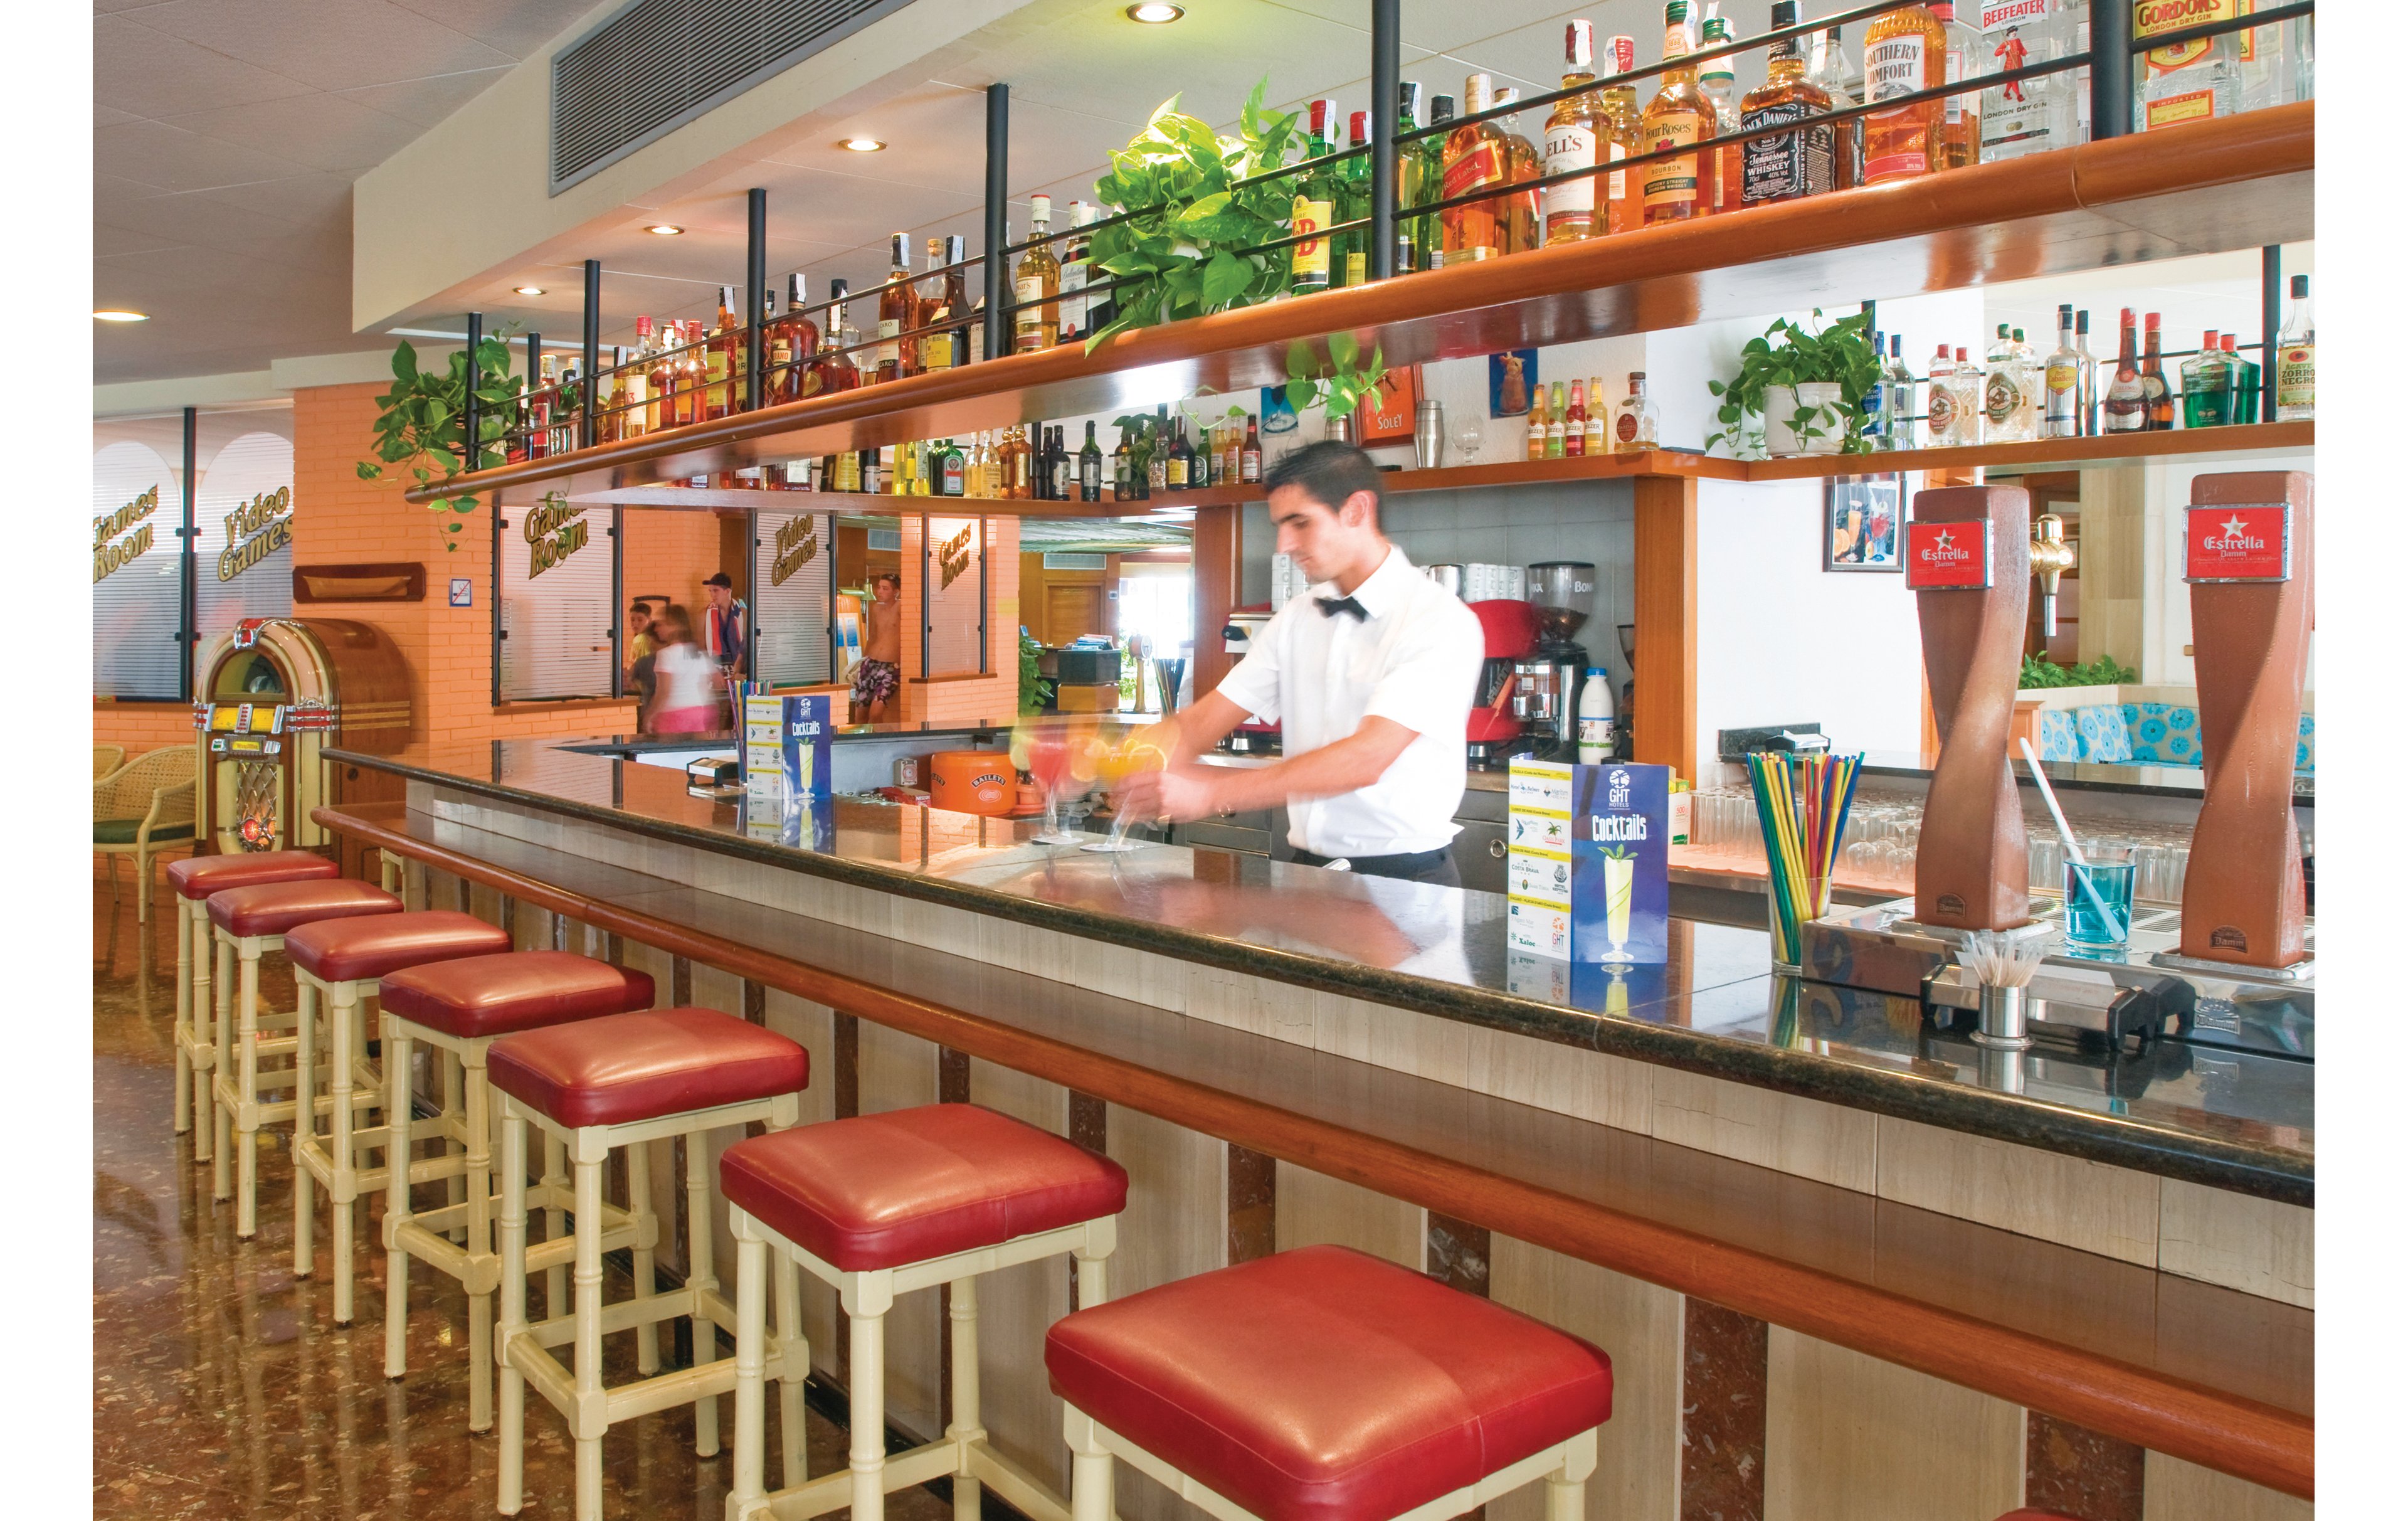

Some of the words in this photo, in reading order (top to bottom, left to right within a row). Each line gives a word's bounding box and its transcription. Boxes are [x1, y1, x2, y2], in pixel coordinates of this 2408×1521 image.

[1983, 0, 2045, 28] BEEFEATER
[2002, 16, 2026, 25] LONDON
[2146, 21, 2176, 33] LONDON
[2180, 16, 2195, 25] DRY
[1866, 44, 1921, 69] SOUTHERN
[1867, 63, 1913, 87] COMFORT
[2157, 94, 2201, 107] IMPORTED
[1983, 109, 2014, 120] LONDON
[2017, 105, 2031, 113] DRY
[1646, 127, 1662, 141] Four
[1662, 123, 1691, 136] Roses
[1749, 151, 1789, 166] Tennessee
[1651, 165, 1681, 176] BOURBON
[1748, 161, 1791, 176] WHISKEY
[1016, 282, 1032, 292] war's
[2281, 369, 2315, 378] ZORRO
[2281, 376, 2315, 386] NEGRO
[223, 486, 290, 548] Video
[524, 507, 588, 544] Gam
[775, 514, 814, 558] Video
[2203, 535, 2265, 550] Estrella
[217, 513, 293, 583] Games
[529, 519, 589, 580] Room
[939, 521, 971, 567] Games
[771, 533, 818, 587] Games
[1921, 548, 1970, 561] Estrella
[941, 549, 970, 591] Room
[800, 708, 811, 717] GHT
[792, 720, 820, 736] Cocktails
[973, 774, 1006, 787] BAILEYS
[1609, 788, 1630, 803] GHT
[1592, 813, 1647, 842] Cocktails
[1519, 937, 1536, 947] Xaloc
[1552, 932, 1565, 947] GHT
[2214, 936, 2244, 947] Damm
